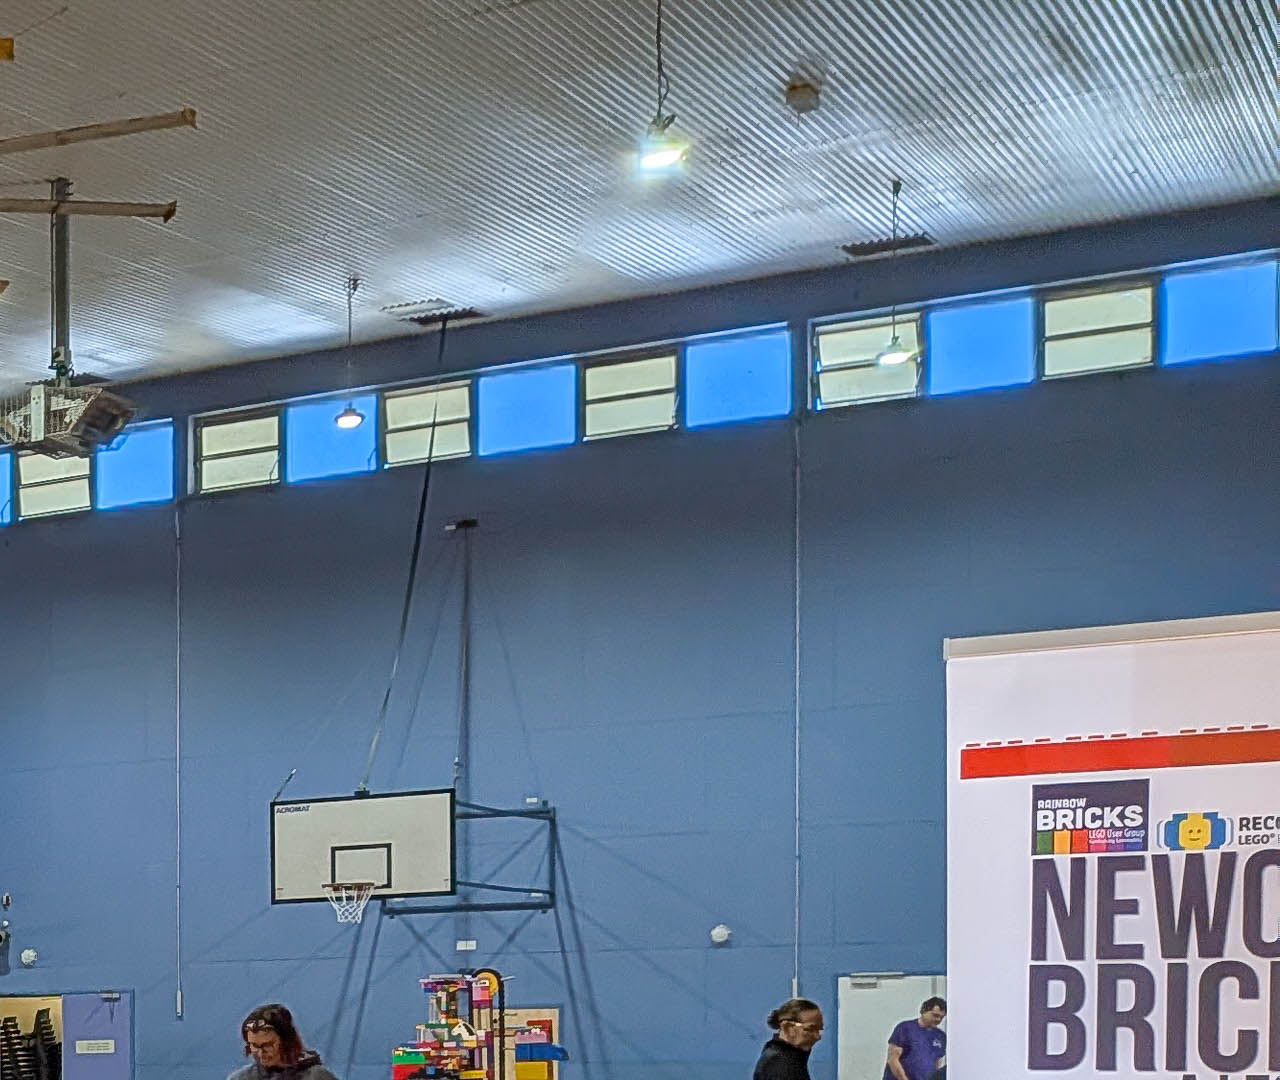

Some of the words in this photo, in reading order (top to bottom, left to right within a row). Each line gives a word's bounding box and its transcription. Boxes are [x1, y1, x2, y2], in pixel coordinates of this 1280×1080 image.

[1037, 798, 1087, 809] RAINBOW
[1036, 805, 1144, 831] BRICKS
[1089, 830, 1106, 839] LEGO
[1107, 829, 1123, 839] User
[1124, 828, 1145, 840] Group
[1028, 960, 1280, 1071] BRIC
